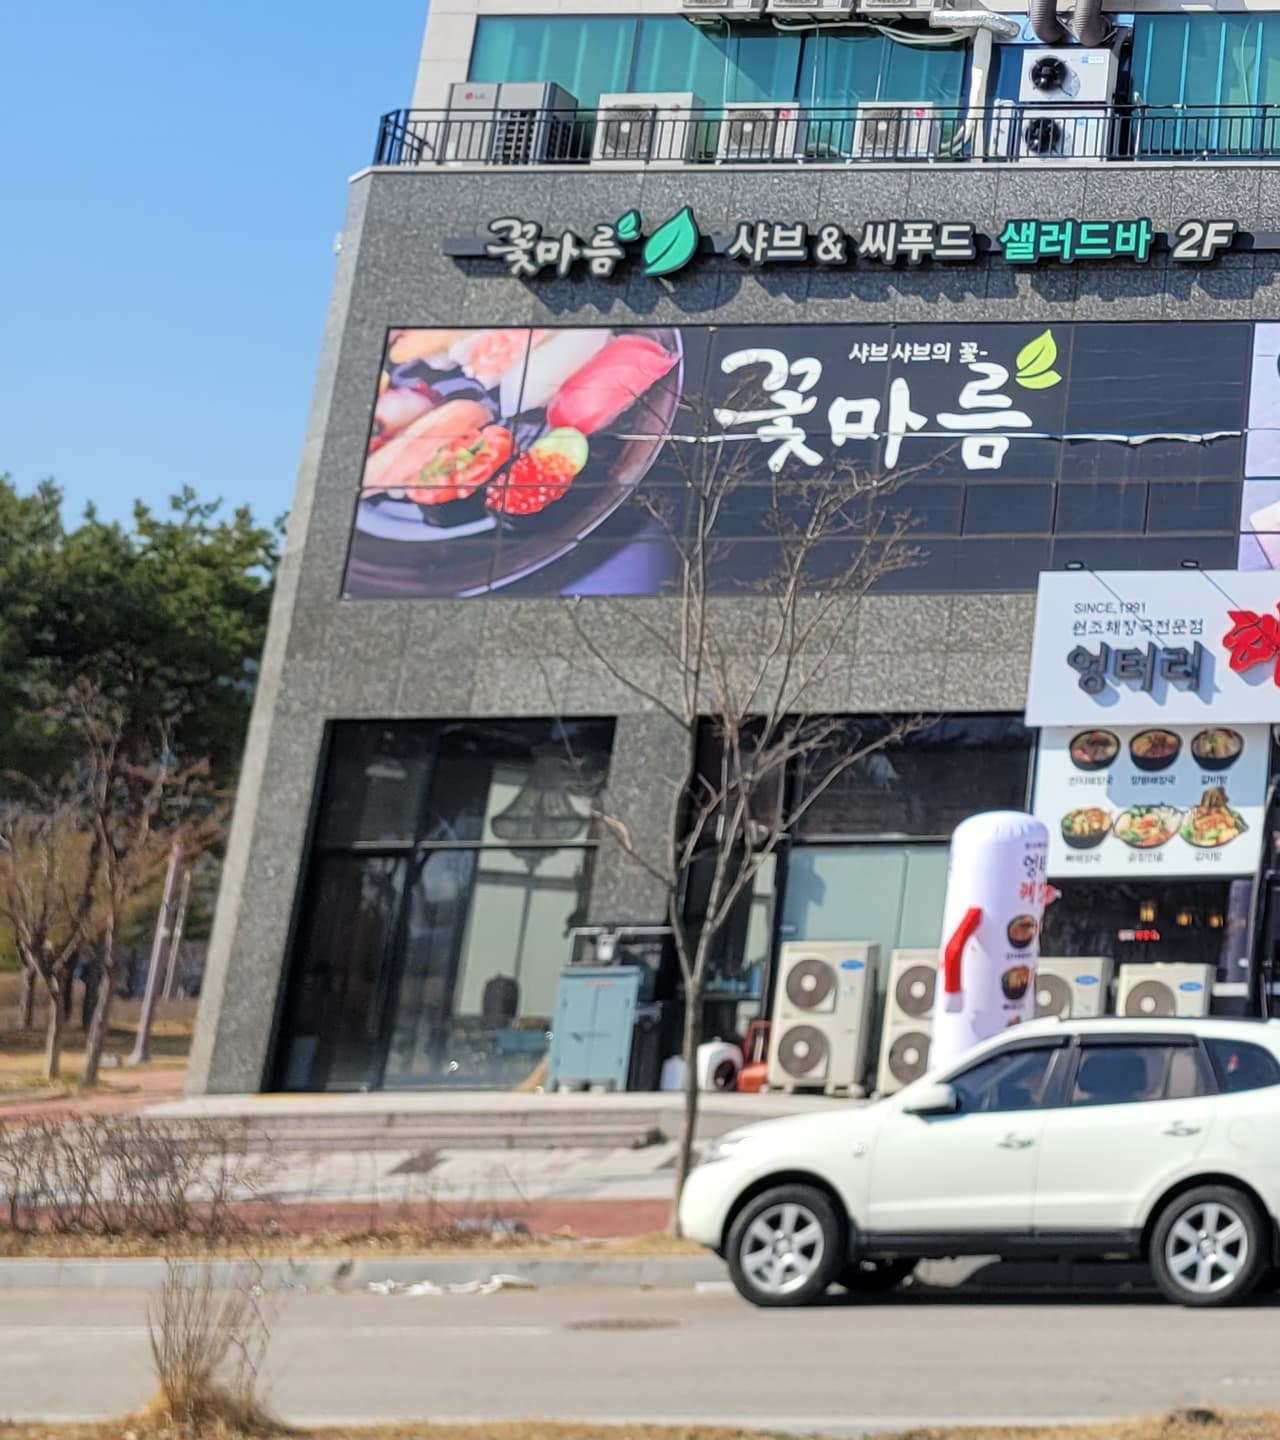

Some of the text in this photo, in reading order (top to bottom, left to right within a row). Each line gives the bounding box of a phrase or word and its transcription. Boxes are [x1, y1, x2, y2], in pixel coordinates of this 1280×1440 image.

[486, 217, 1238, 277] 꽃마름 샤브 & 씨푸드 샐러드바 2F
[713, 348, 1033, 473] 꽃마름
[1119, 601, 1147, 614] 1991
[1066, 640, 1202, 695] 엉터리
